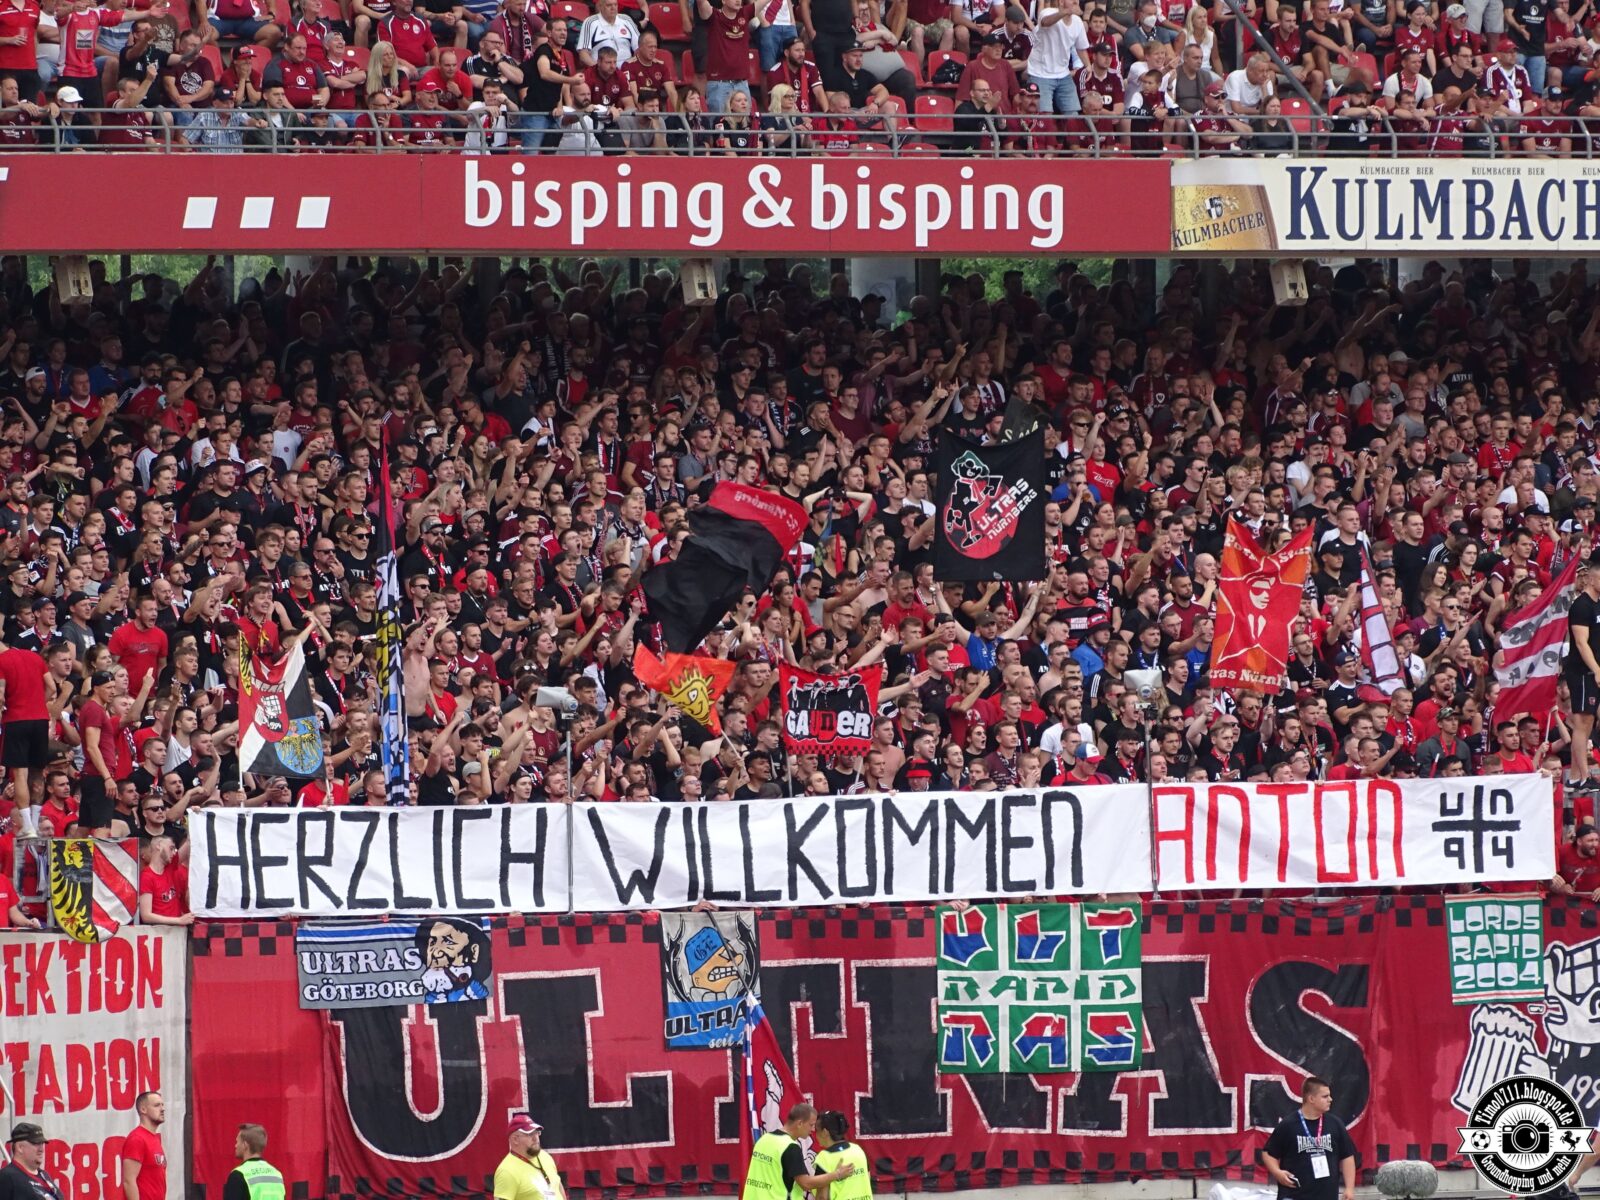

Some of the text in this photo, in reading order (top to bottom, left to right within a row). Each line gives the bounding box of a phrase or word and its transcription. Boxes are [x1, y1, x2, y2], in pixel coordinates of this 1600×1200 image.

[1360, 165, 1434, 175] KULMBACHER BIER
[1471, 166, 1545, 176] KULMBACHER BIER
[464, 160, 1065, 248] bisping & bisping
[1285, 166, 1600, 241] KULMBACH
[1172, 211, 1266, 248] KULMBACHER
[205, 778, 1405, 909] HERZLICH WILLKOMMEN ANTON
[1449, 904, 1540, 933] LORDS
[300, 947, 423, 974] ULTRAS
[1451, 934, 1540, 962] RAPID
[0, 935, 163, 1017] EKTION
[303, 978, 424, 1001] GÖTEBORG
[943, 974, 1137, 1001] RAPID
[1453, 961, 1541, 990] 2004
[665, 997, 748, 1039] ULTRA
[0, 1037, 160, 1117] TADION
